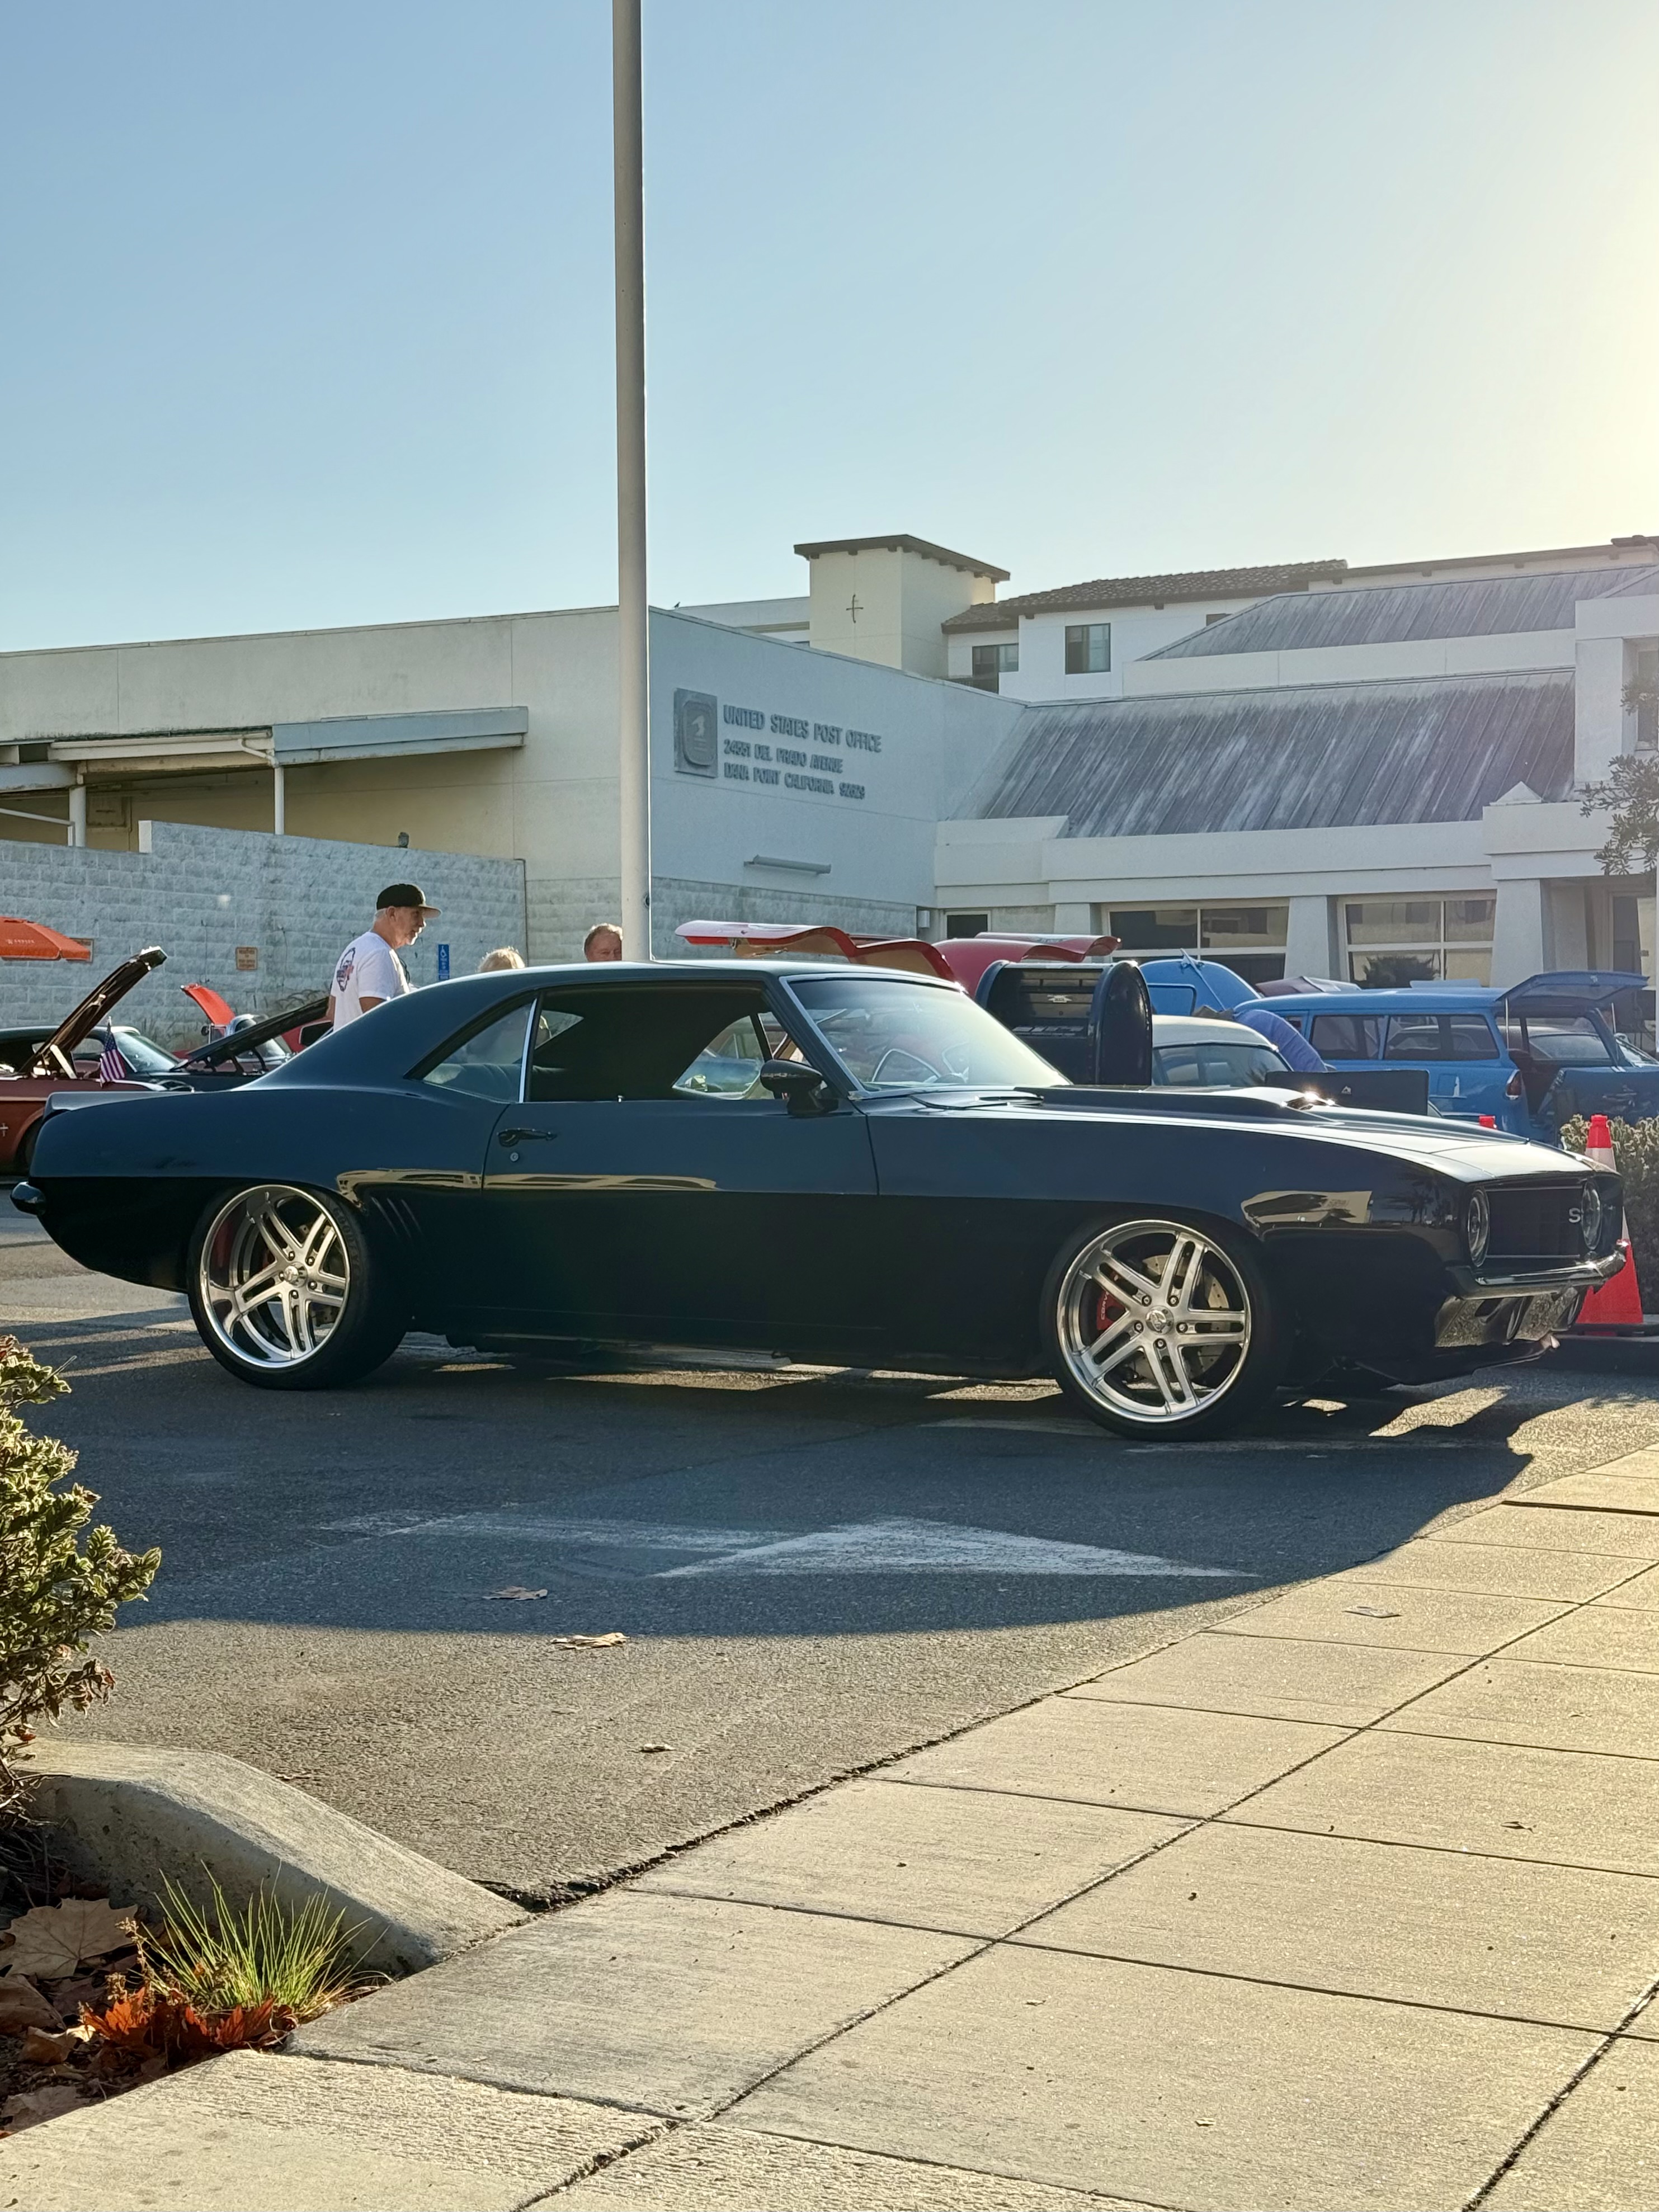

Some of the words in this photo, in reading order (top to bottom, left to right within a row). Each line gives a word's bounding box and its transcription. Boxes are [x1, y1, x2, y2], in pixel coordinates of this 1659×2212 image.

[723, 705, 765, 729] UNITED
[770, 714, 809, 739] STATES
[814, 723, 842, 745] POST
[846, 729, 882, 753] OFFICE
[724, 739, 751, 757] 24551
[754, 744, 773, 761] DEL
[776, 748, 807, 767] PRADO
[809, 754, 843, 774] AVENUE
[724, 762, 750, 781] DANA
[753, 767, 781, 785] POINT
[784, 772, 835, 795] CALIFORNIA
